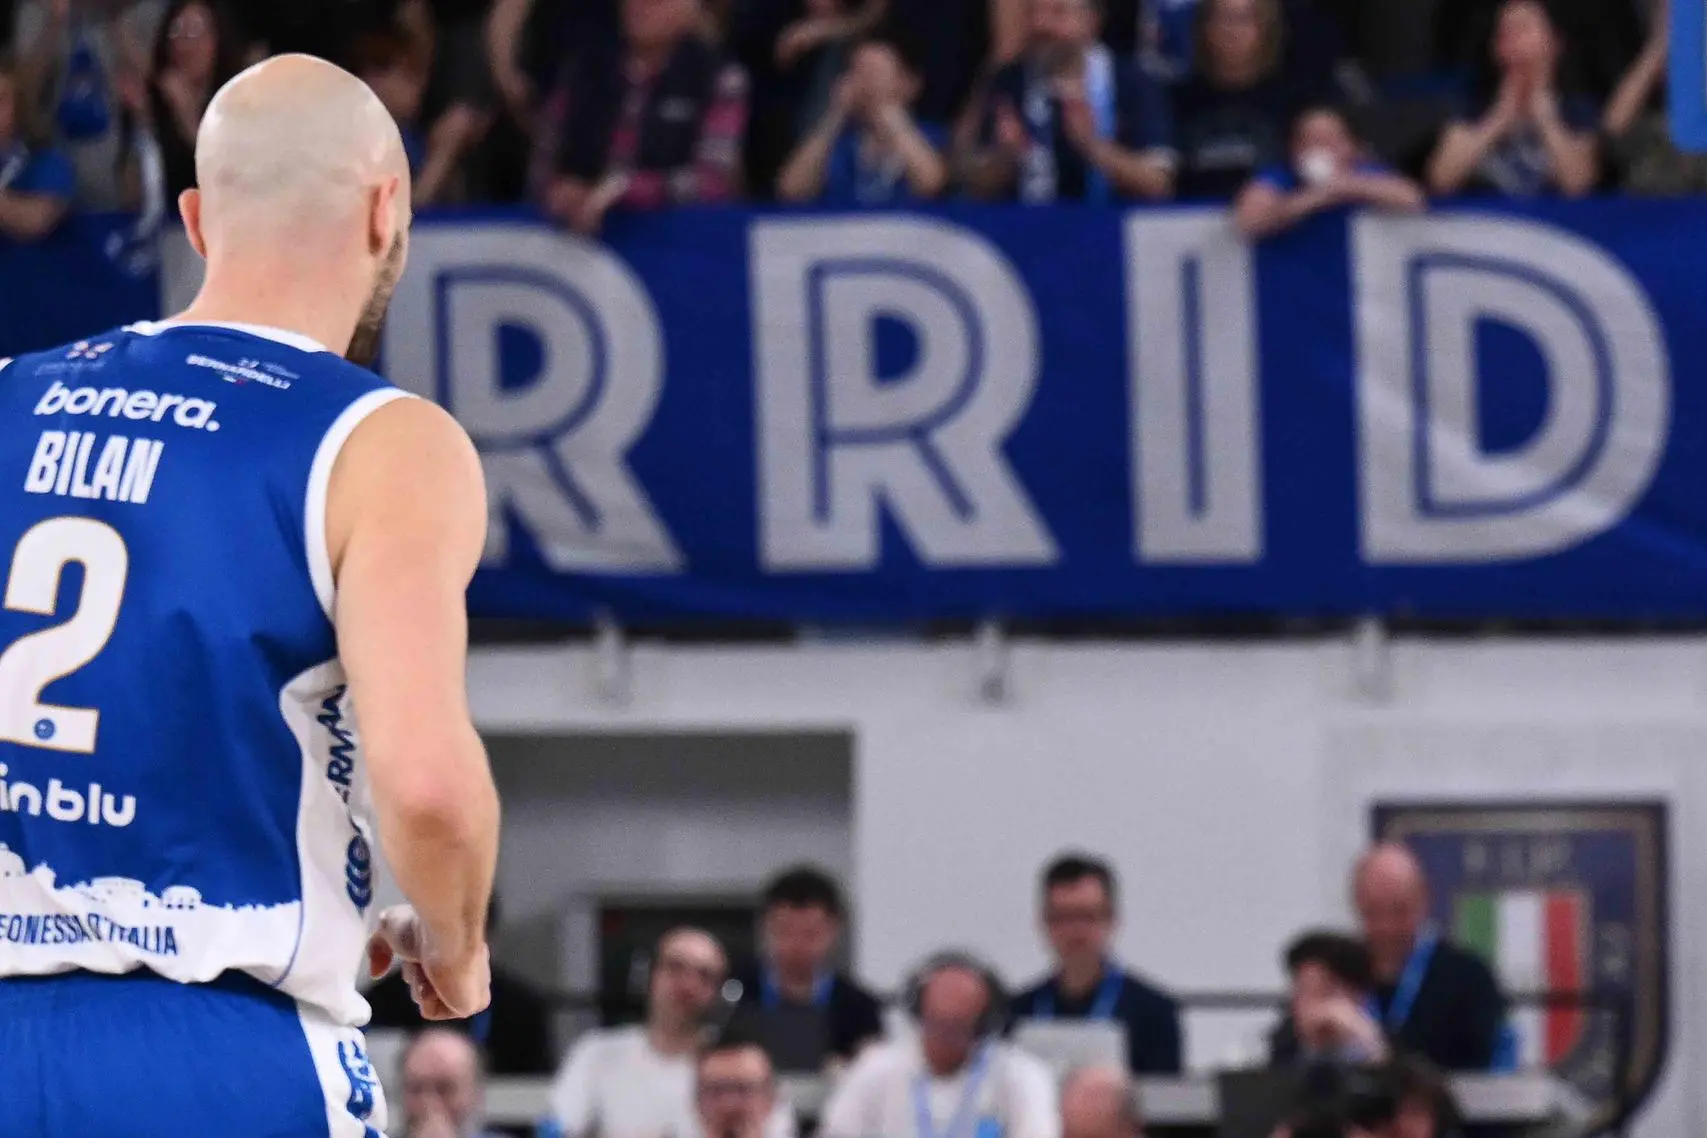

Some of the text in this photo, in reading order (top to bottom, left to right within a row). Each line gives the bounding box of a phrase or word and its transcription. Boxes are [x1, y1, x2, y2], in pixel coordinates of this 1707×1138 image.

[33, 380, 221, 432] bonera.
[24, 429, 165, 503] BILAN
[0, 516, 129, 754] 2
